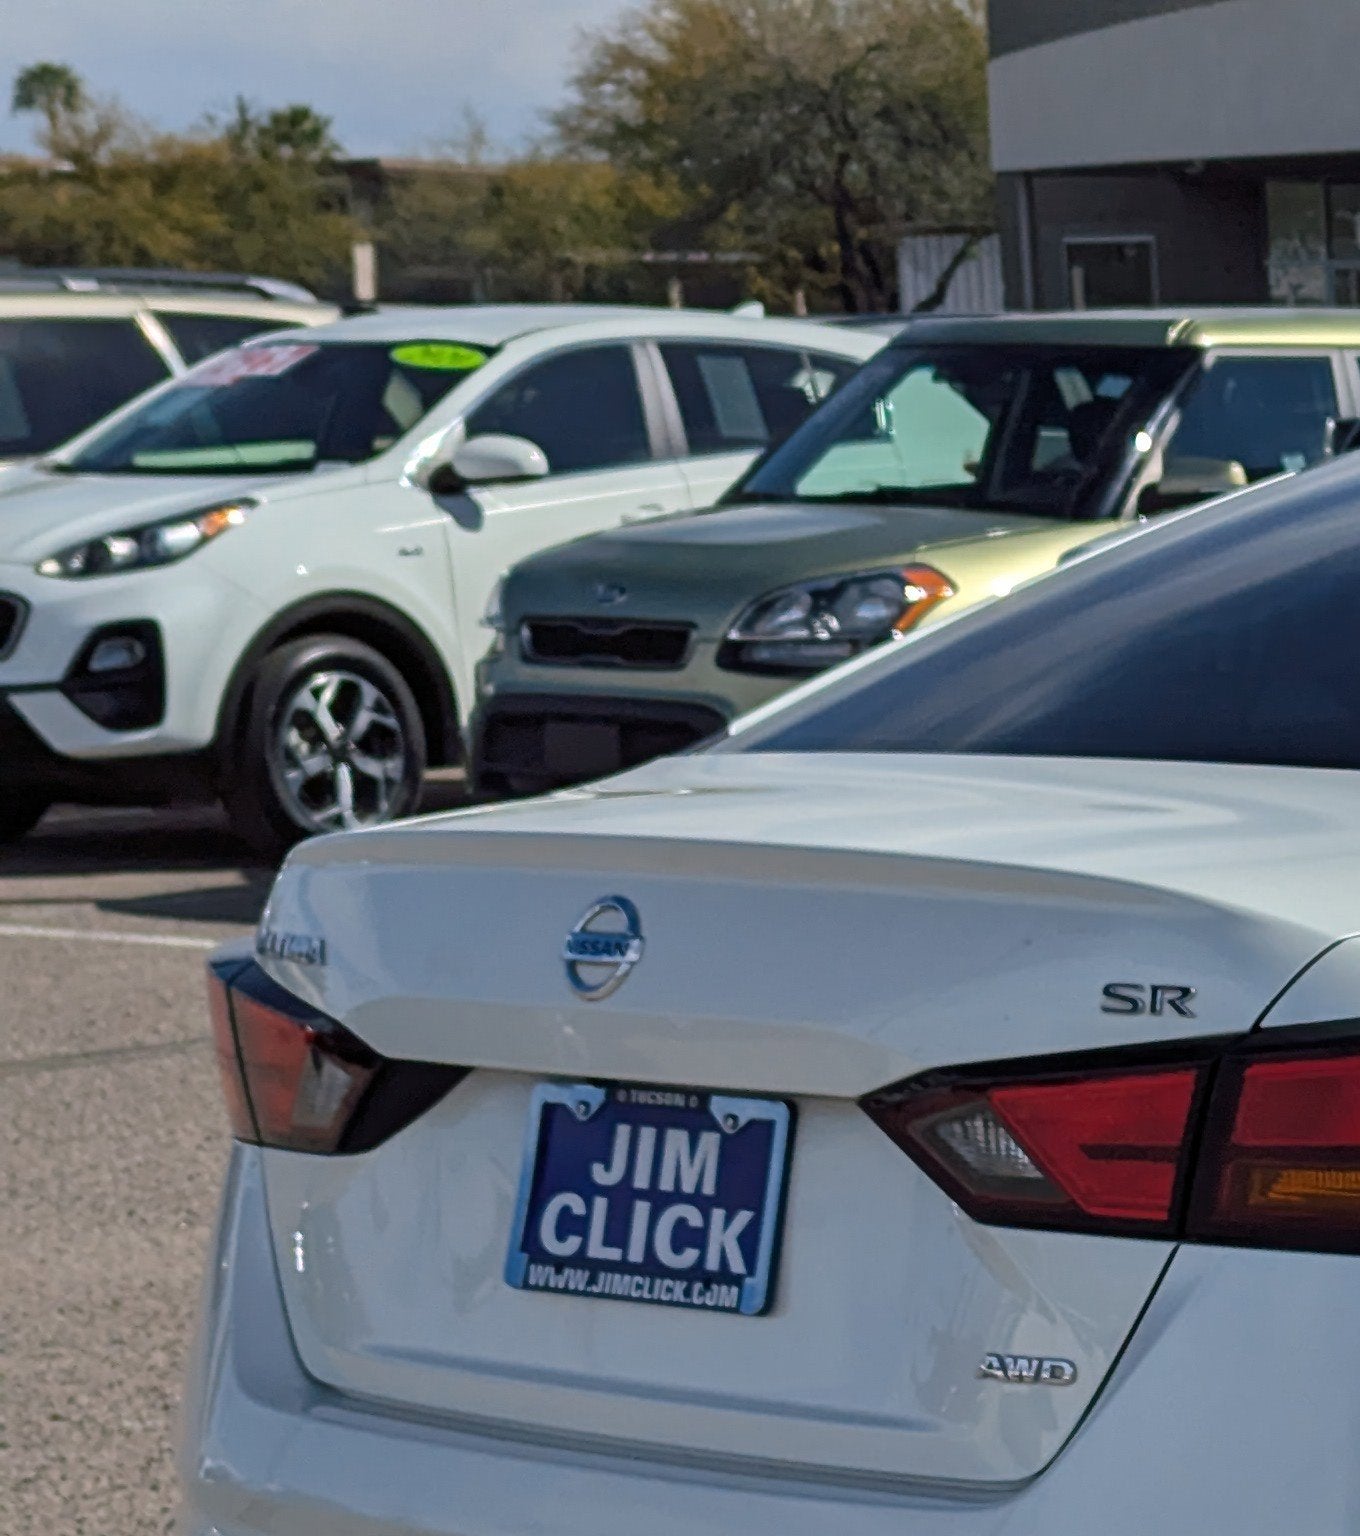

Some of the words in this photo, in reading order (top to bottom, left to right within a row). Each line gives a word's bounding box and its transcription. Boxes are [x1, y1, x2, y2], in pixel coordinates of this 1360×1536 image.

[1101, 983, 1198, 1019] SR
[591, 1123, 722, 1197] JIM
[540, 1192, 755, 1276] CLICK
[528, 1263, 739, 1308] WWW.JIMCLICK.COM
[978, 1352, 1078, 1387] AWD
